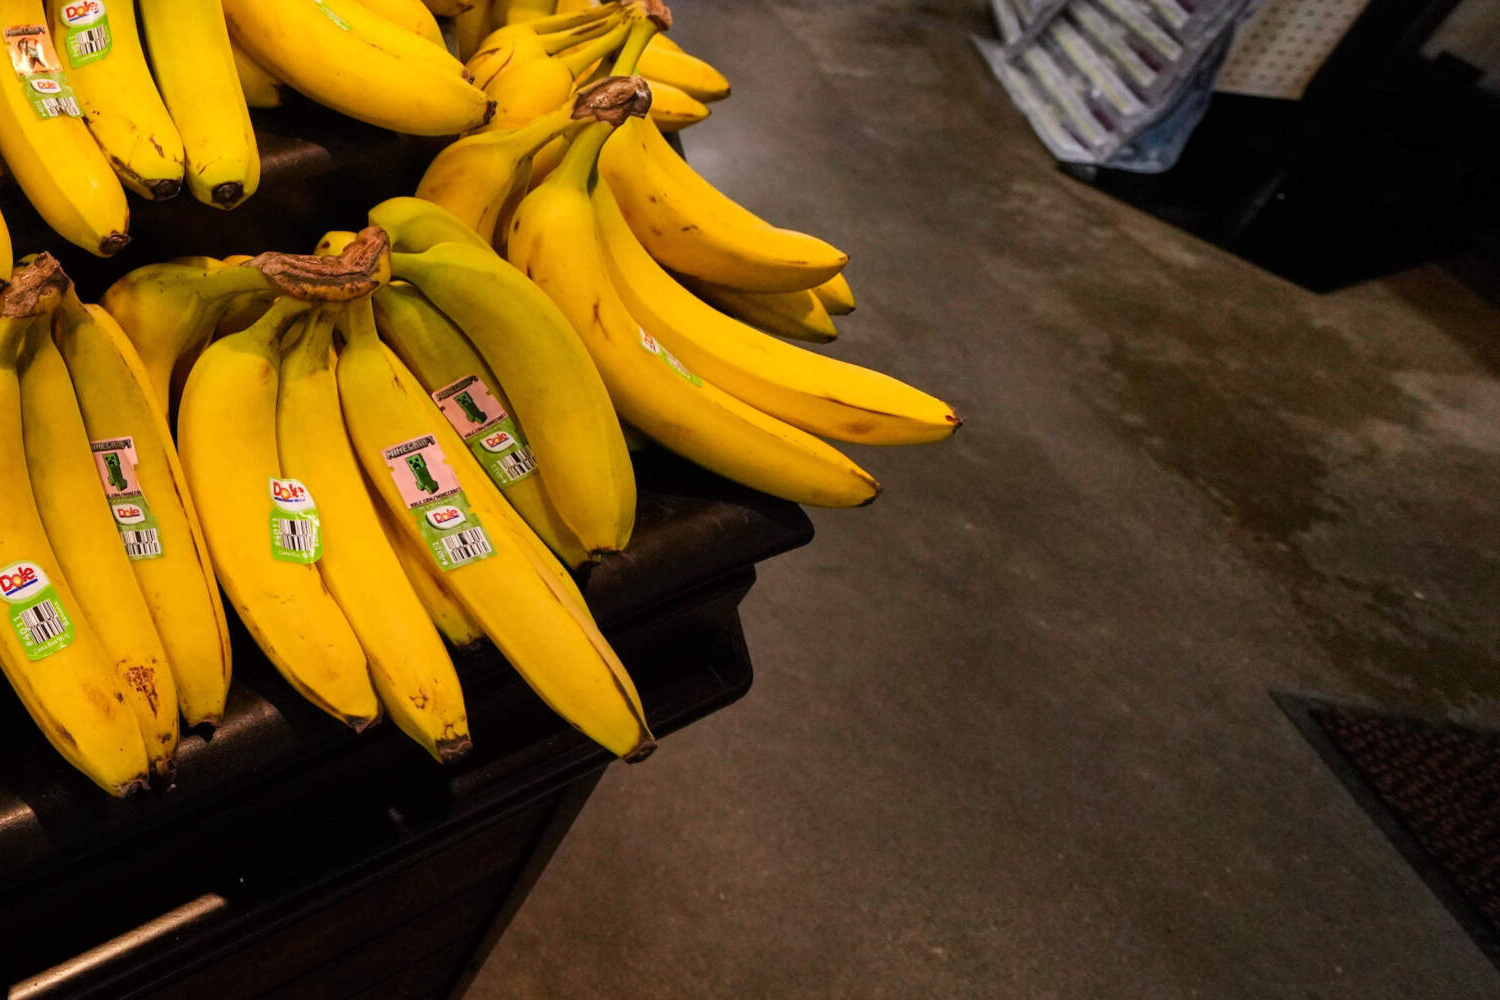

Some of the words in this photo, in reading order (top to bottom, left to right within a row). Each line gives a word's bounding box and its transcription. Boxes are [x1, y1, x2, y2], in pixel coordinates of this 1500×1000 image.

[66, 1, 98, 18] Dole
[486, 432, 509, 448] Dole
[273, 481, 305, 500] Dole
[117, 507, 140, 518] Dole
[433, 508, 459, 524] Dole
